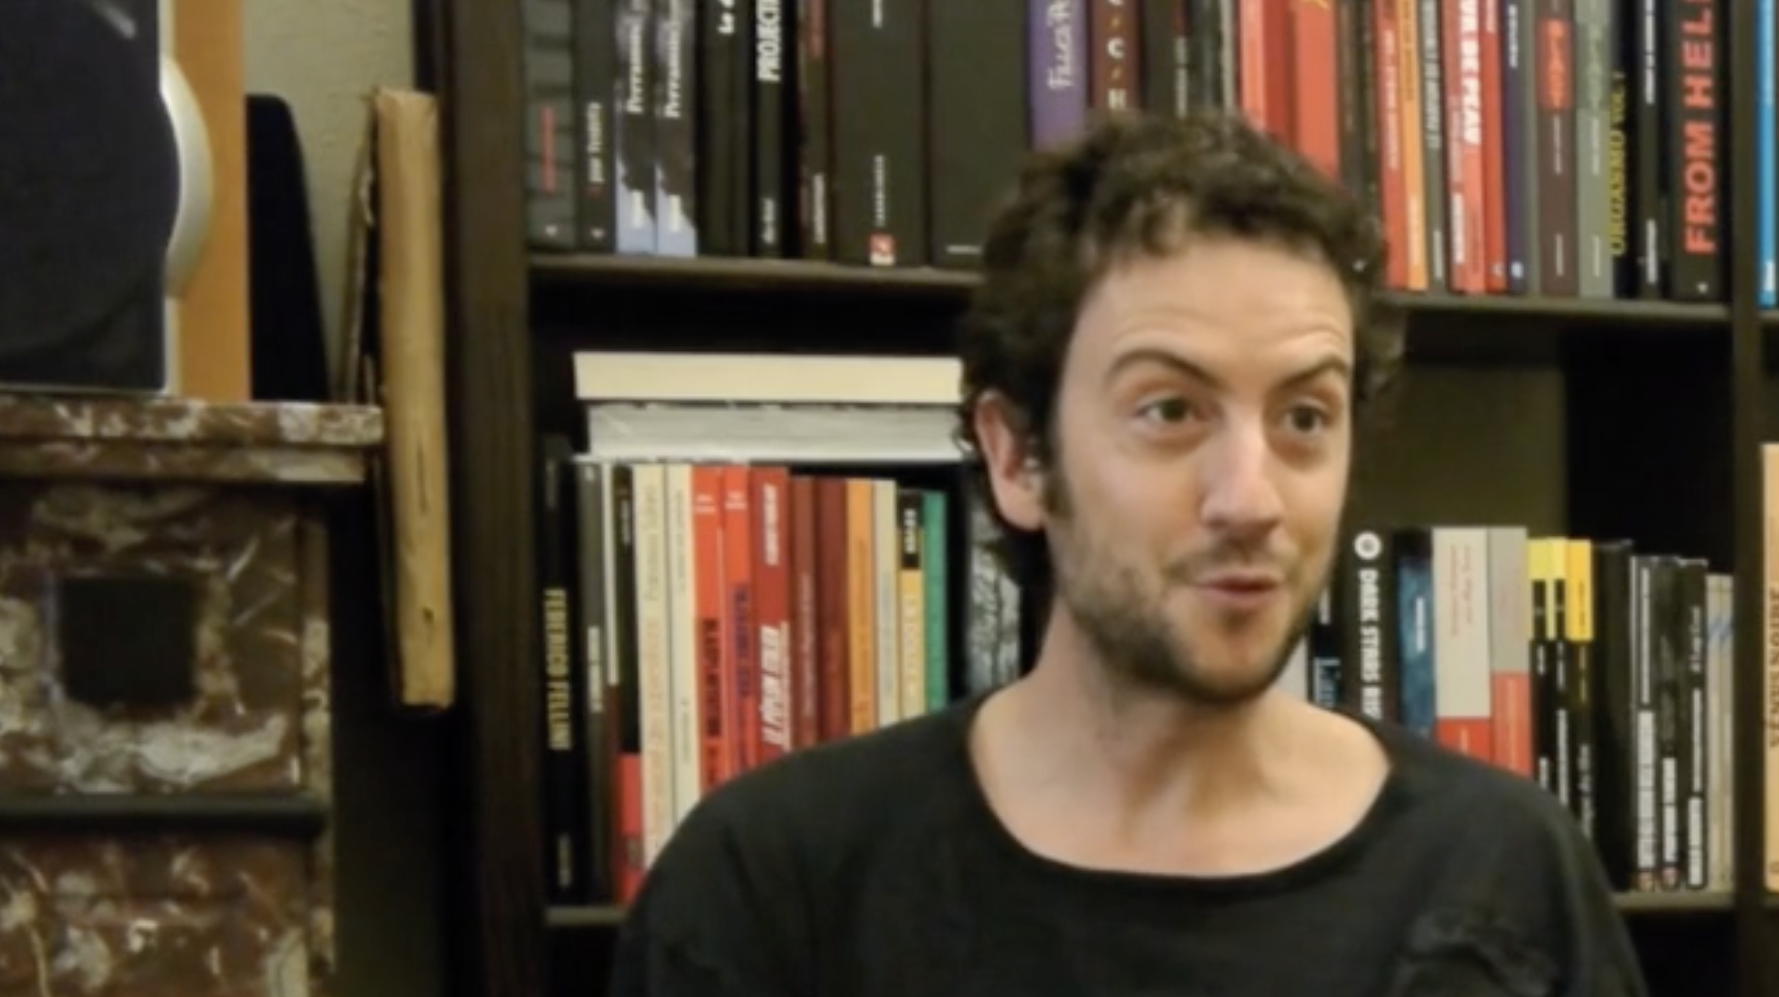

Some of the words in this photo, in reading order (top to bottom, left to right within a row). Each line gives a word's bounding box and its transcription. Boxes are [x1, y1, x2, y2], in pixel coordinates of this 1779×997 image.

[1683, 0, 1713, 108] HEL
[1685, 121, 1715, 254] FROM
[545, 589, 570, 676] FEDERICO
[1359, 569, 1380, 622] DARK
[1361, 626, 1382, 682] STARS
[549, 679, 572, 750] FELLINI
